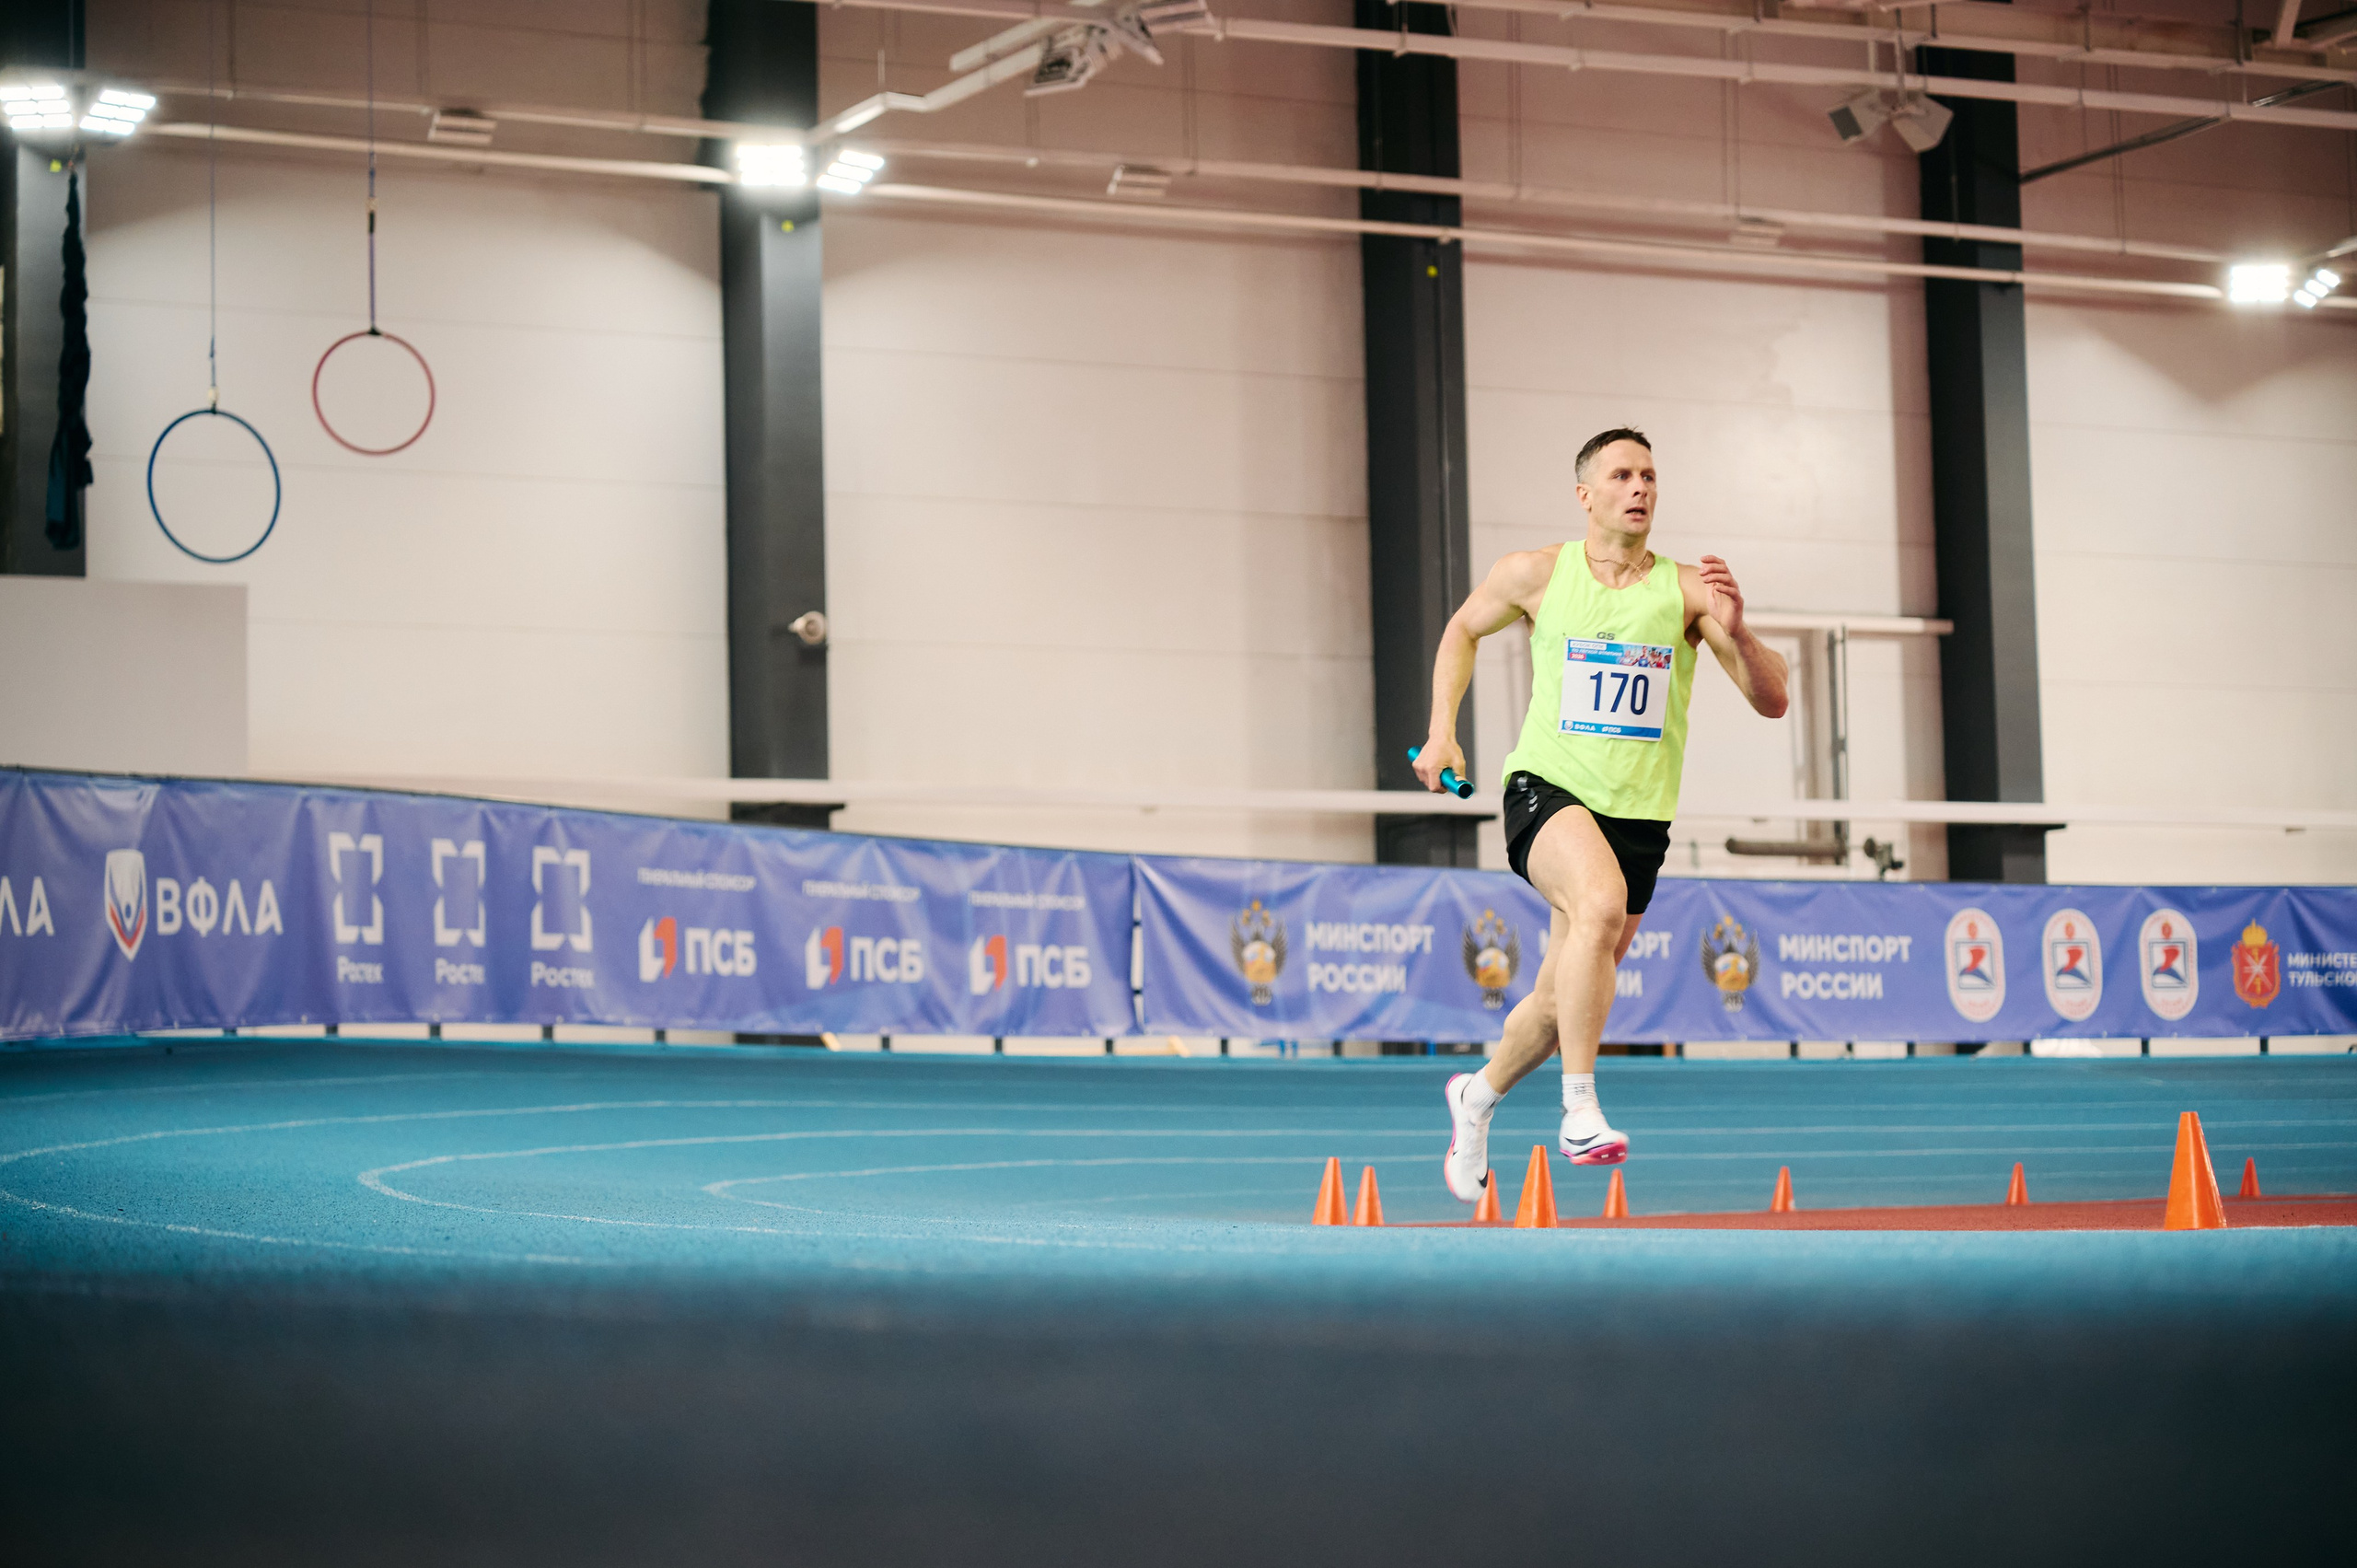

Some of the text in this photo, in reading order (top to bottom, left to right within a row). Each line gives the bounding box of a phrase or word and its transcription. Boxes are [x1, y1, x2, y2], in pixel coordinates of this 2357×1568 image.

[1589, 670, 1649, 715] 170
[157, 877, 284, 937] ВФЛА
[684, 926, 758, 978] ПСБ
[1305, 922, 1435, 954] МИНСПОРТ
[1778, 933, 1912, 963] МИНСПОРТ
[850, 935, 924, 983] ПСБ
[1016, 944, 1092, 990] ПСБ
[1307, 962, 1407, 993] РОССИИ
[1781, 970, 1884, 1000] РОССИИ
[2288, 970, 2357, 987] ТУЛЬСКО
